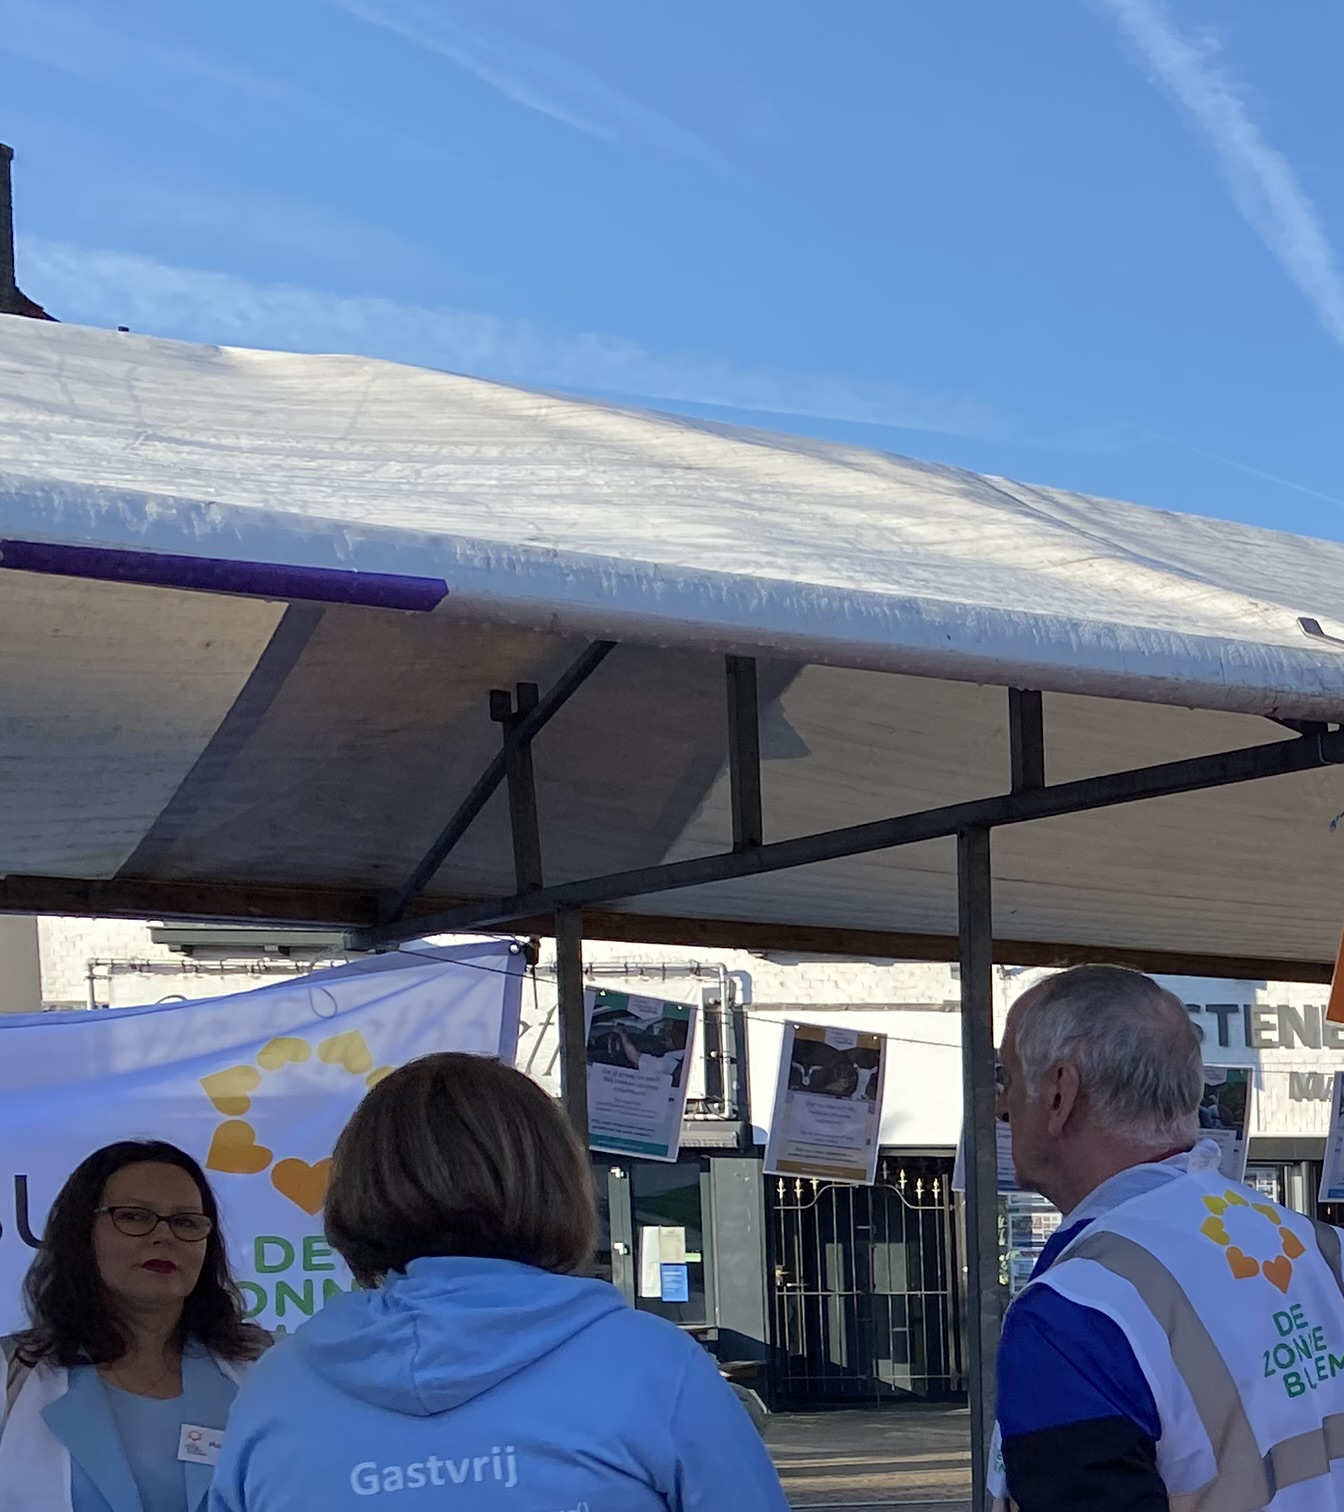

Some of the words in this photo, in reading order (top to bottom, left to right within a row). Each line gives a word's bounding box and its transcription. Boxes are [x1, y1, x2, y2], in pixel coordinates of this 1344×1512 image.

[255, 1235, 336, 1274] DE
[1272, 1303, 1308, 1337] DE
[350, 1445, 518, 1496] Gastvrij
